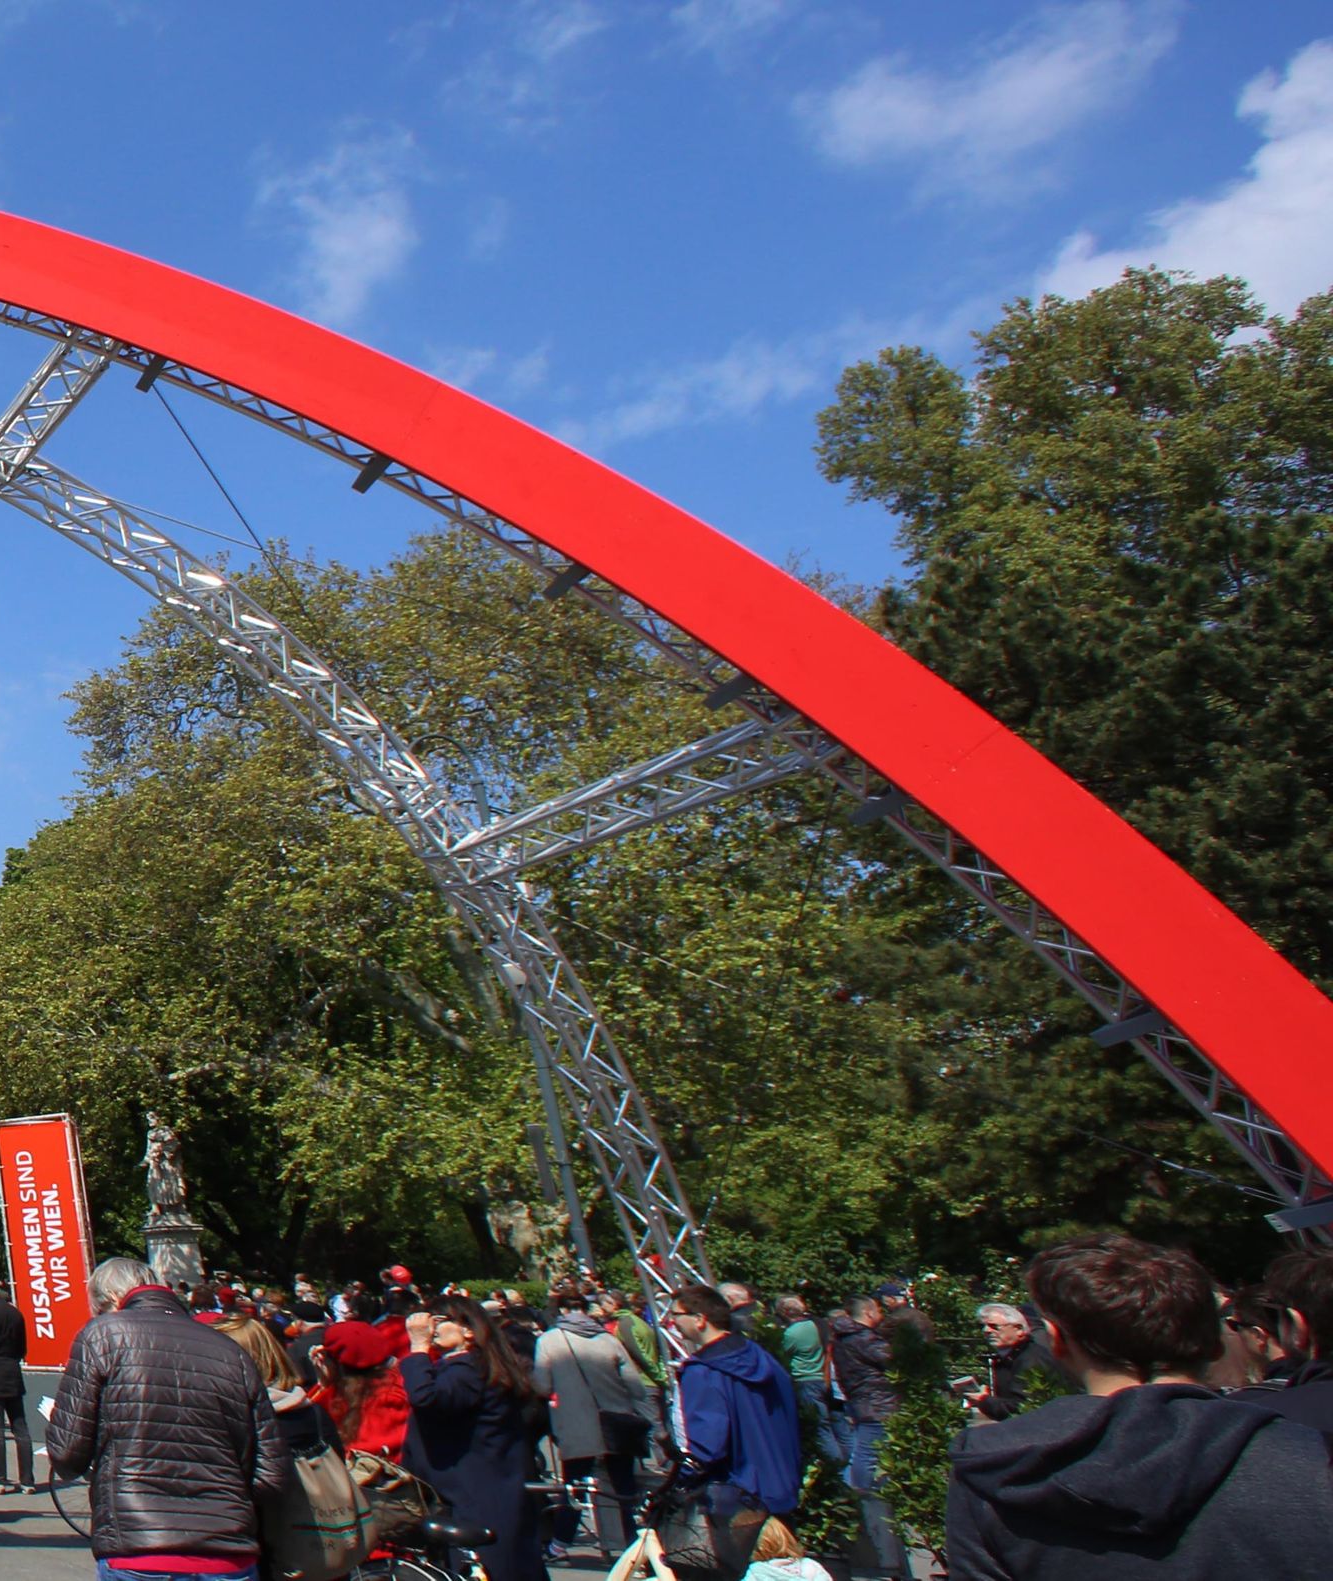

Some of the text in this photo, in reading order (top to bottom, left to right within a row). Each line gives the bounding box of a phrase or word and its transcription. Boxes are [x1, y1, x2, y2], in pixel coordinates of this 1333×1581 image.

[15, 1150, 55, 1340] ZUSAMMEN SIND
[42, 1183, 72, 1302] WIR WIEN.
